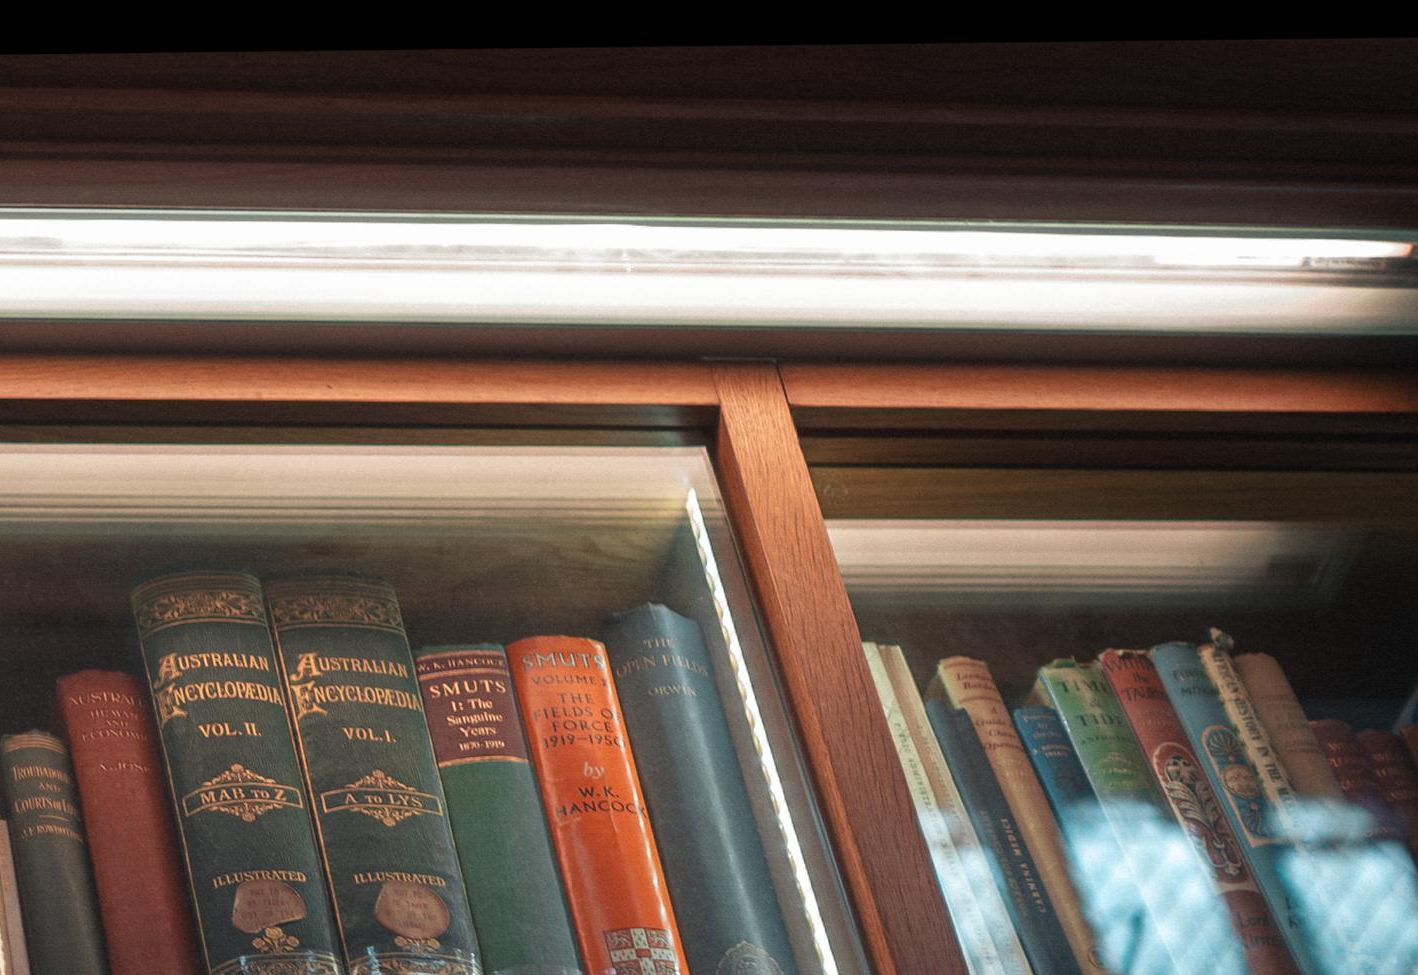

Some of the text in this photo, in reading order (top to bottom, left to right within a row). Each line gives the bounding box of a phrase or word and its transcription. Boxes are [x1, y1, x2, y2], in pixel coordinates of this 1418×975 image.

[644, 637, 674, 649] THE
[290, 652, 408, 682] AUSTRALIAN
[434, 657, 506, 670] K. HANCOCK
[522, 651, 604, 670] SMUTS
[616, 653, 708, 677] OPEN FIELDS
[154, 652, 270, 690] AUSTRALIAN
[532, 674, 598, 687] VOLUME
[1058, 681, 1110, 694] TIME
[429, 679, 507, 698] SMUTS
[648, 685, 698, 697] ORWIN
[154, 681, 285, 728] ENCYCLOPÆDIA
[291, 681, 423, 720] ENCYCLOPÆDIA
[470, 699, 494, 711] The
[558, 692, 593, 705] THE
[446, 712, 503, 727] Sanguine
[532, 707, 595, 721] FIELDS
[1075, 714, 1123, 727] TIDE
[105, 720, 129, 728] AND
[198, 722, 263, 738] VOL. II.
[459, 725, 497, 737] Years
[552, 718, 613, 733] FORCE
[342, 727, 398, 743] VOL. I.
[583, 761, 605, 780] by
[1257, 745, 1269, 758] IN
[1265, 762, 1281, 783] THE
[38, 782, 61, 792] AND
[579, 786, 619, 799] W. K.
[251, 789, 287, 801] TO Z
[344, 793, 358, 804] A
[364, 795, 383, 804] TO
[14, 796, 52, 814] COURTS
[212, 870, 307, 888] ILLUSTRATED
[354, 872, 447, 888] ILLUSTRATED
